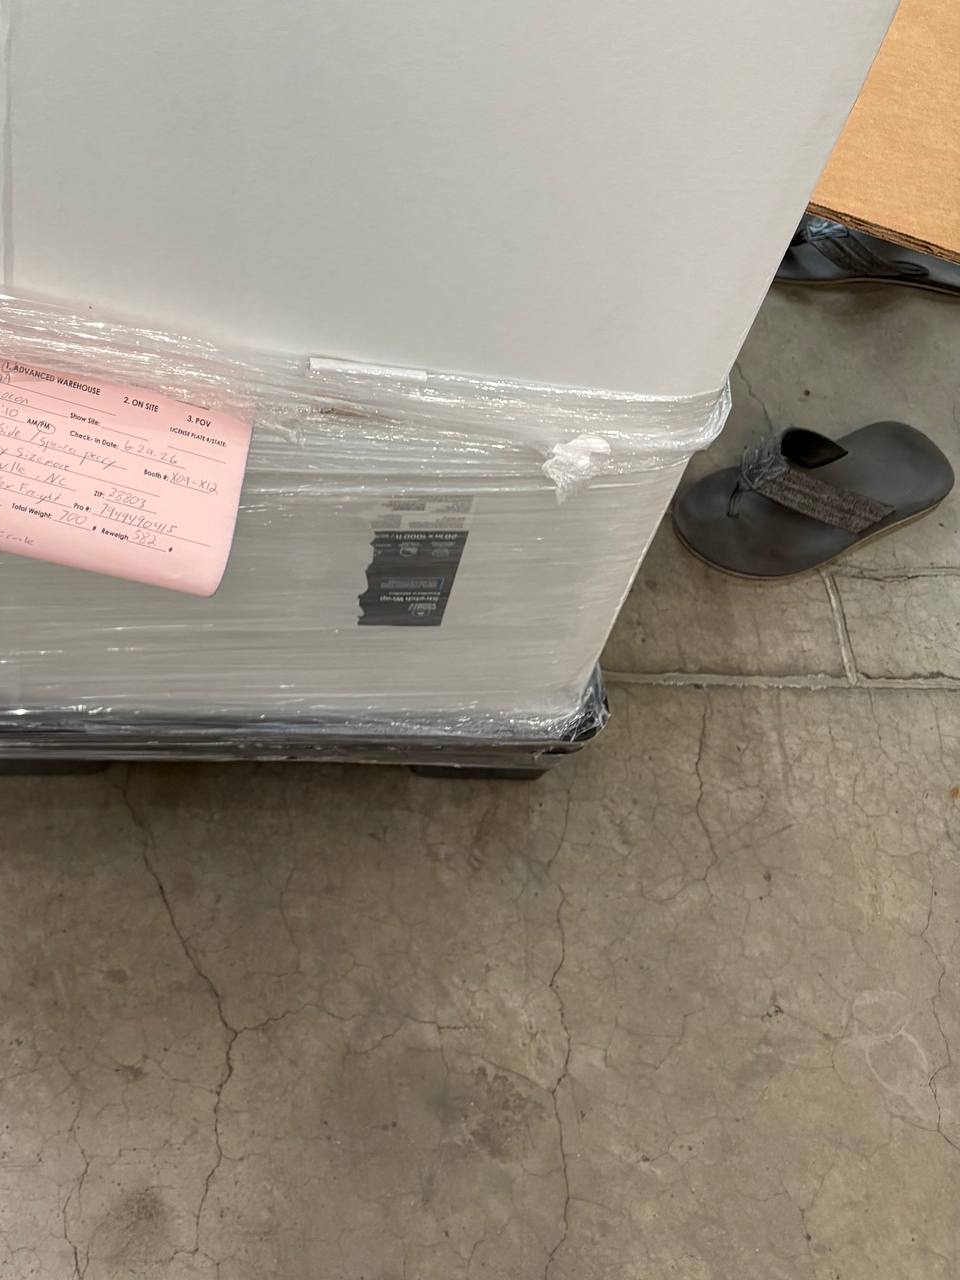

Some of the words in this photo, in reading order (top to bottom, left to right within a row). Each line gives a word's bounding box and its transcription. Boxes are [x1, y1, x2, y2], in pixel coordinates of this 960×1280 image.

[13, 365, 59, 382] ADVANCED
[57, 376, 101, 396] WAREHOUSE
[123, 396, 130, 406] 2.
[131, 399, 144, 409] ON
[145, 402, 159, 413] SITE
[186, 414, 194, 423] 3.
[195, 417, 212, 429] POV
[70, 412, 87, 422] Show
[88, 417, 101, 427] Site:
[69, 430, 93, 441] Check-
[102, 439, 120, 449] Date:
[169, 426, 190, 437] LICENSE
[191, 432, 206, 442] PLATE
[143, 468, 162, 480] Booth
[94, 490, 105, 499] ZIP:
[108, 487, 147, 509] 28803
[11, 502, 28, 513] Total
[28, 507, 54, 521] Weight:
[73, 502, 84, 512] Pro
[59, 509, 88, 526] 700
[101, 527, 129, 542] Reweigh
